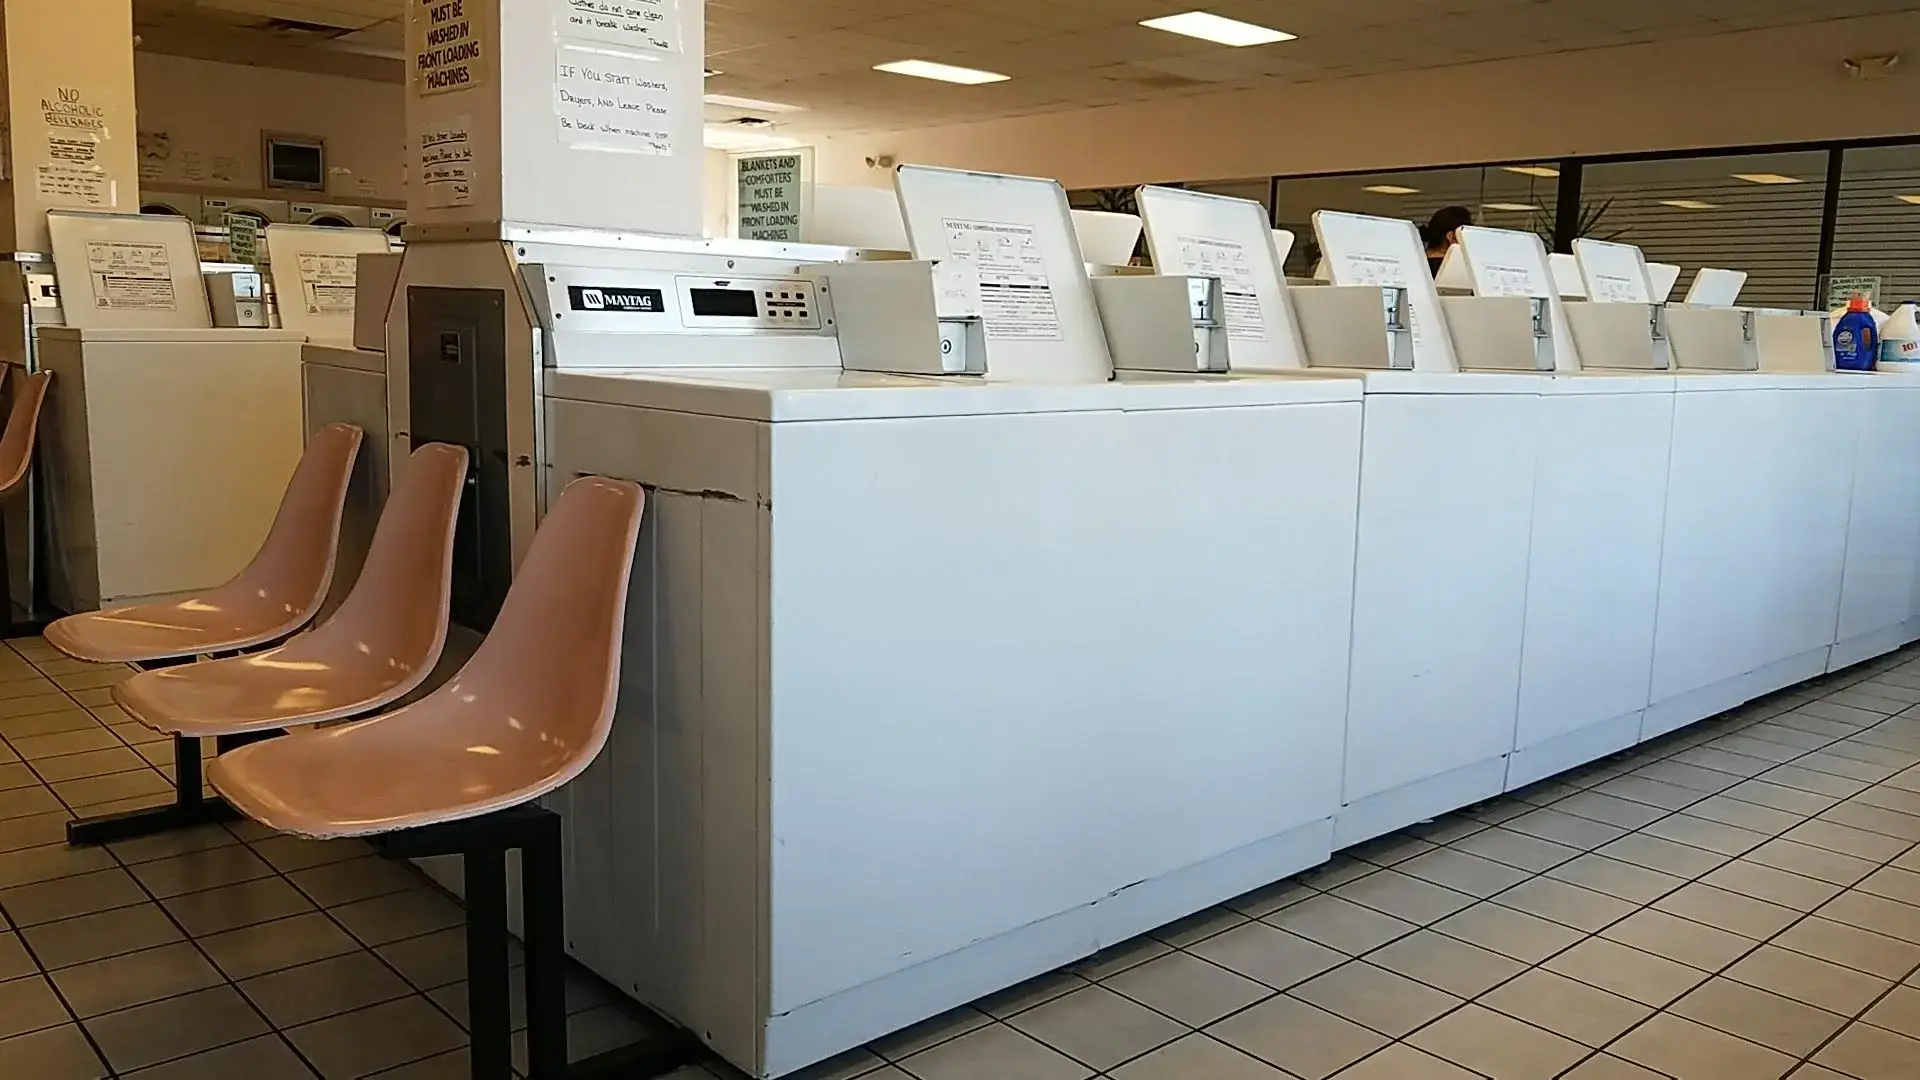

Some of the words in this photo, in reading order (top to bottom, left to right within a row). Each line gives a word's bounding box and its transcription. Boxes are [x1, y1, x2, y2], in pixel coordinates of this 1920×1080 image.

[431, 4, 451, 24] MUST
[453, 0, 463, 17] BE
[427, 24, 459, 46] WASHED
[460, 20, 470, 38] IN
[417, 51, 442, 70] FRONT
[443, 41, 480, 64] LOADING
[427, 66, 470, 89] MACHINES
[560, 65, 575, 77] IF
[57, 86, 80, 102] NO
[41, 98, 104, 118] ALCOHOLIC
[44, 113, 104, 129] BEVERAGES
[741, 158, 778, 172] BLANKETS
[779, 157, 796, 169] AND
[745, 172, 792, 186] COMFORTERS
[754, 188, 773, 199] MUST
[775, 187, 784, 198] BE
[751, 202, 779, 213] WASHED
[780, 201, 790, 211] IN
[741, 216, 764, 228] FRONT
[766, 214, 798, 227] LOADING
[751, 229, 789, 240] MACHINES
[604, 294, 652, 306] MAYTAG
